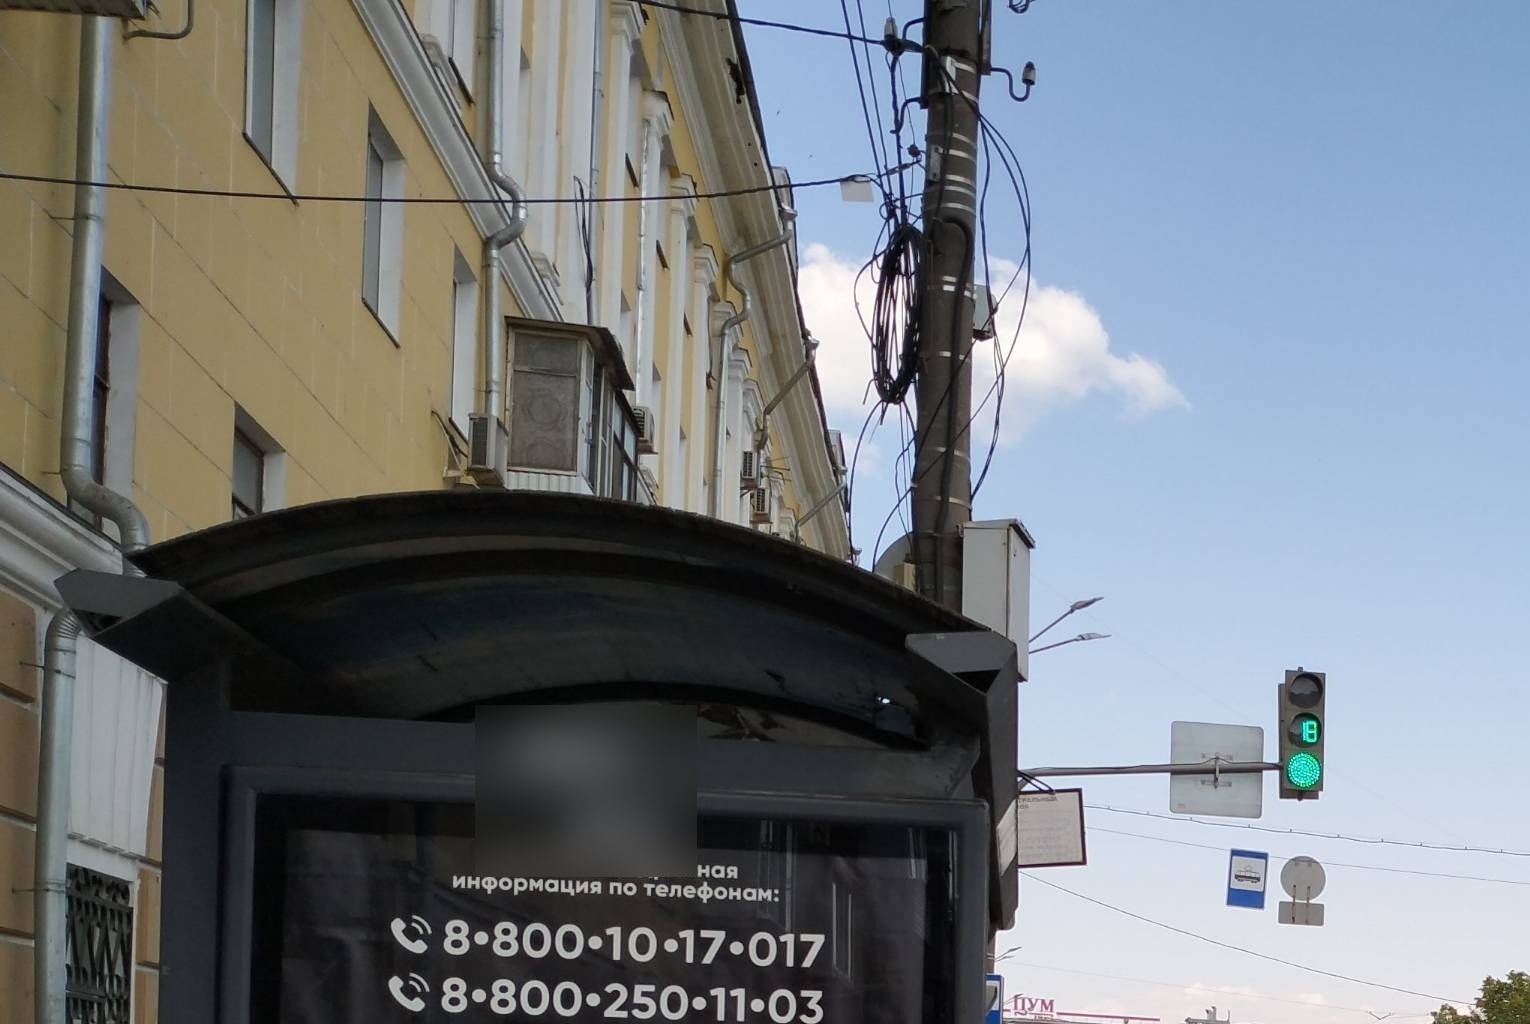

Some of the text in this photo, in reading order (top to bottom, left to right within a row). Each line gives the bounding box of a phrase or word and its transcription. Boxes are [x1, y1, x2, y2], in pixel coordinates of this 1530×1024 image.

[452, 876, 779, 904] информация по телефонам:
